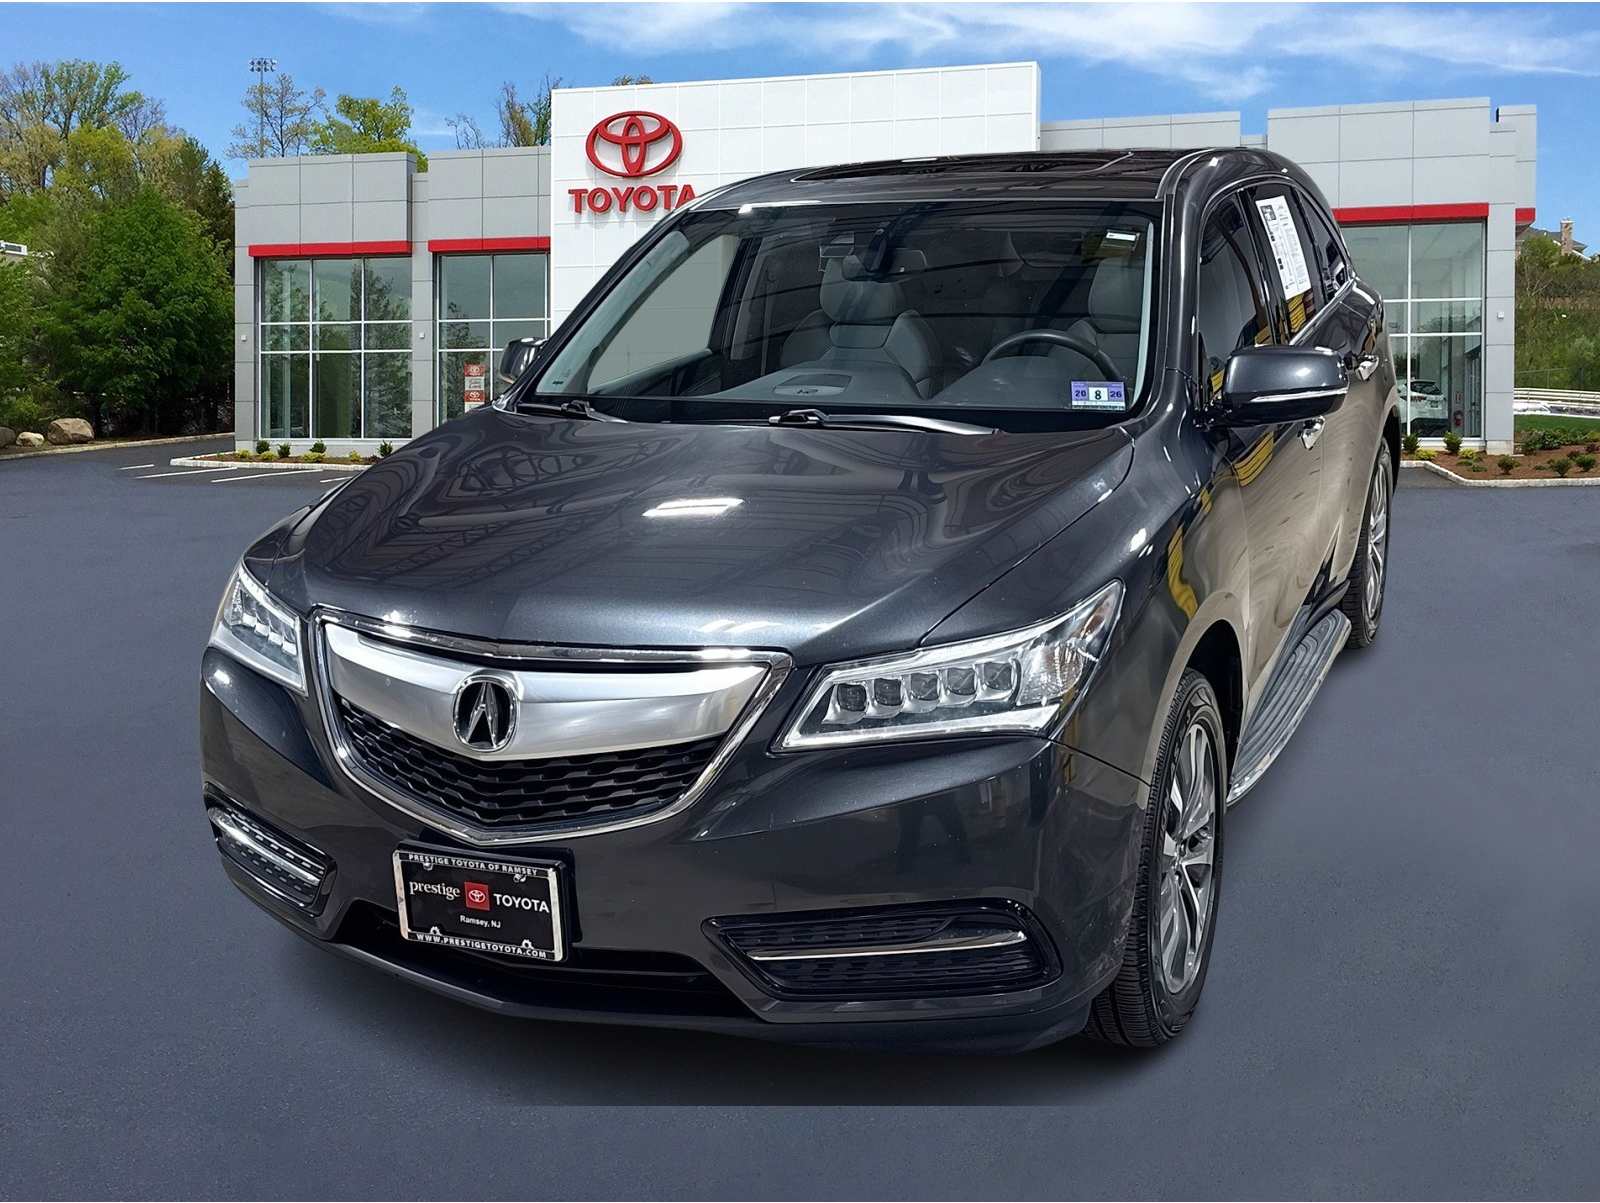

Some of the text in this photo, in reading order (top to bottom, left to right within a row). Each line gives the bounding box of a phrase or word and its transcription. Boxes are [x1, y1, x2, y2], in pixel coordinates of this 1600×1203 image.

[568, 184, 696, 213] TOYOTA
[1094, 389, 1102, 400] 8
[409, 854, 537, 876] PRESTIGE TOYOTA OF RAMSEY
[409, 881, 550, 913] prestige TOYOTA
[460, 914, 501, 928] Ramsey, NJ
[416, 933, 547, 958] WWW.PRESTIGETOYOTA.COM
